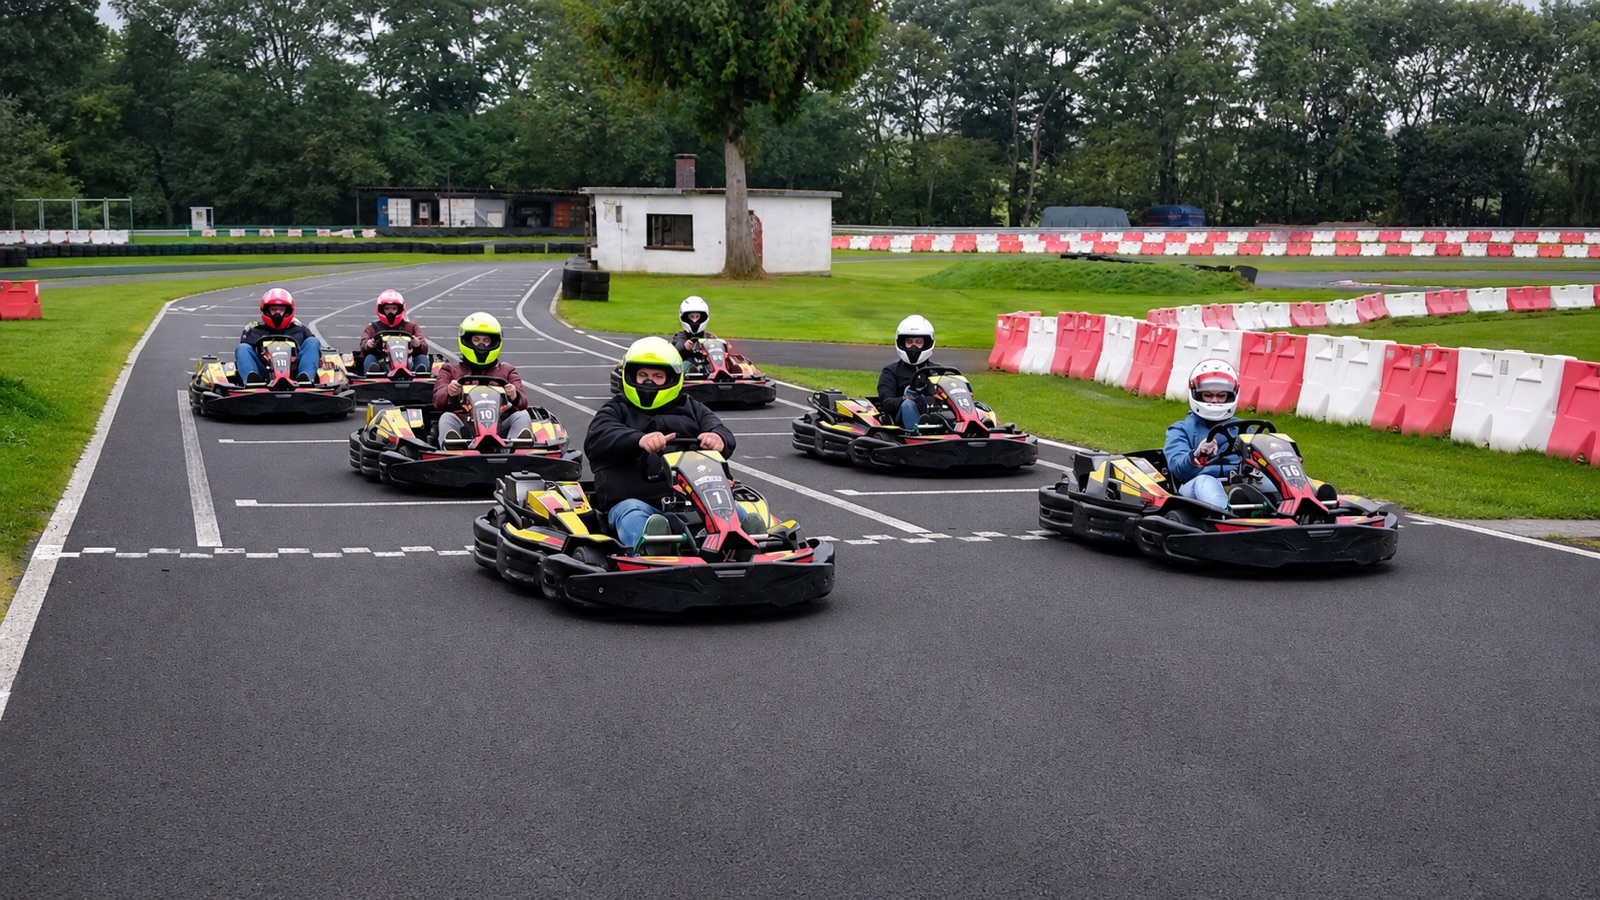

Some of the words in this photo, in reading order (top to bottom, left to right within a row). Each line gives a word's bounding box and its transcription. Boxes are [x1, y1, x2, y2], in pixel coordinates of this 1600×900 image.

[480, 410, 492, 419] 10
[1281, 465, 1300, 477] 16
[712, 491, 722, 504] 1
